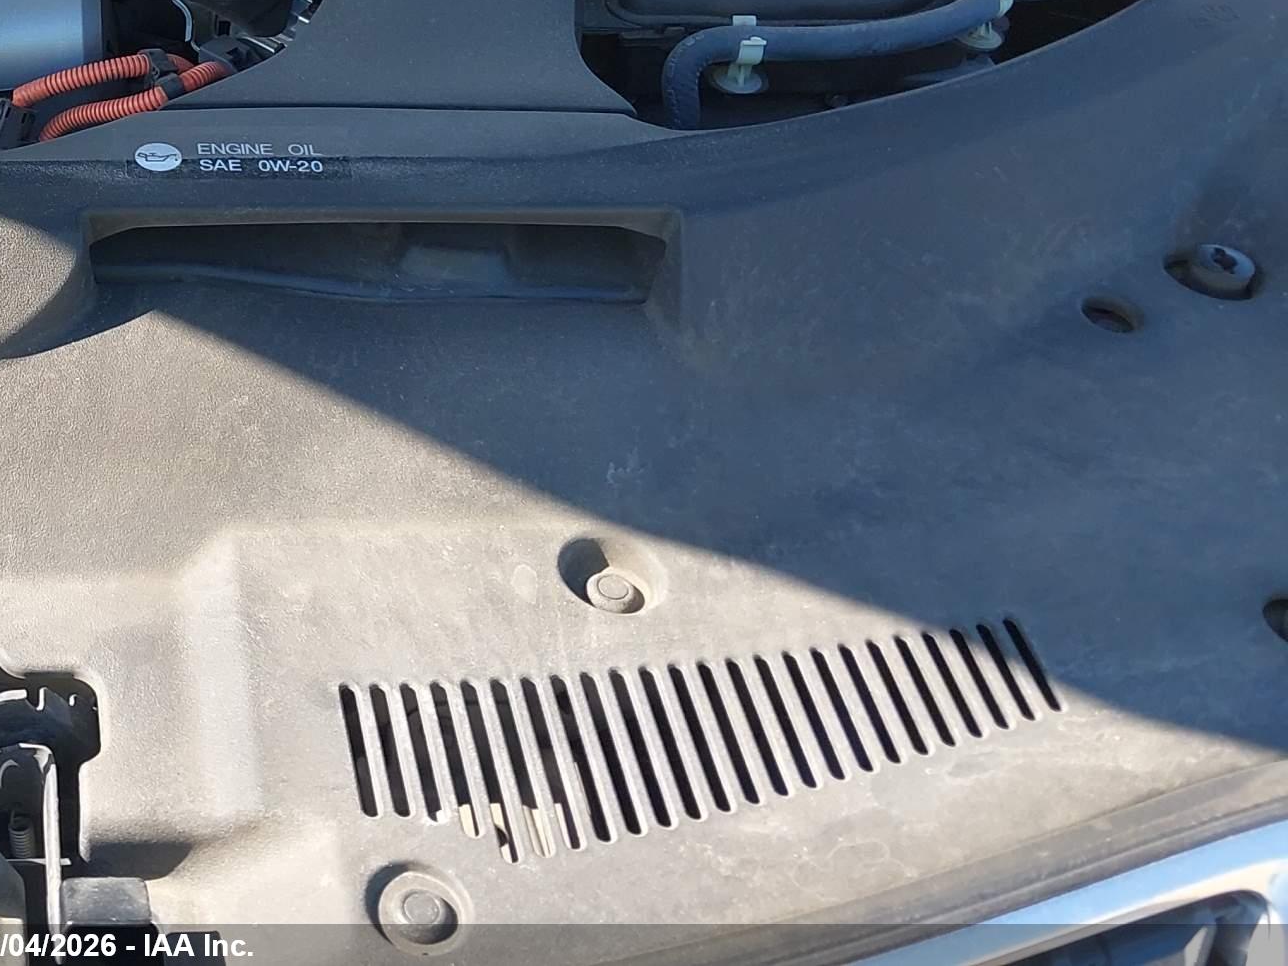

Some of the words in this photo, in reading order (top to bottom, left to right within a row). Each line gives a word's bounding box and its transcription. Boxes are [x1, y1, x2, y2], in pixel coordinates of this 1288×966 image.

[197, 143, 273, 156] ENGINE
[287, 144, 323, 157] OIL
[199, 159, 242, 172] SAE
[258, 160, 324, 173] 0W-20
